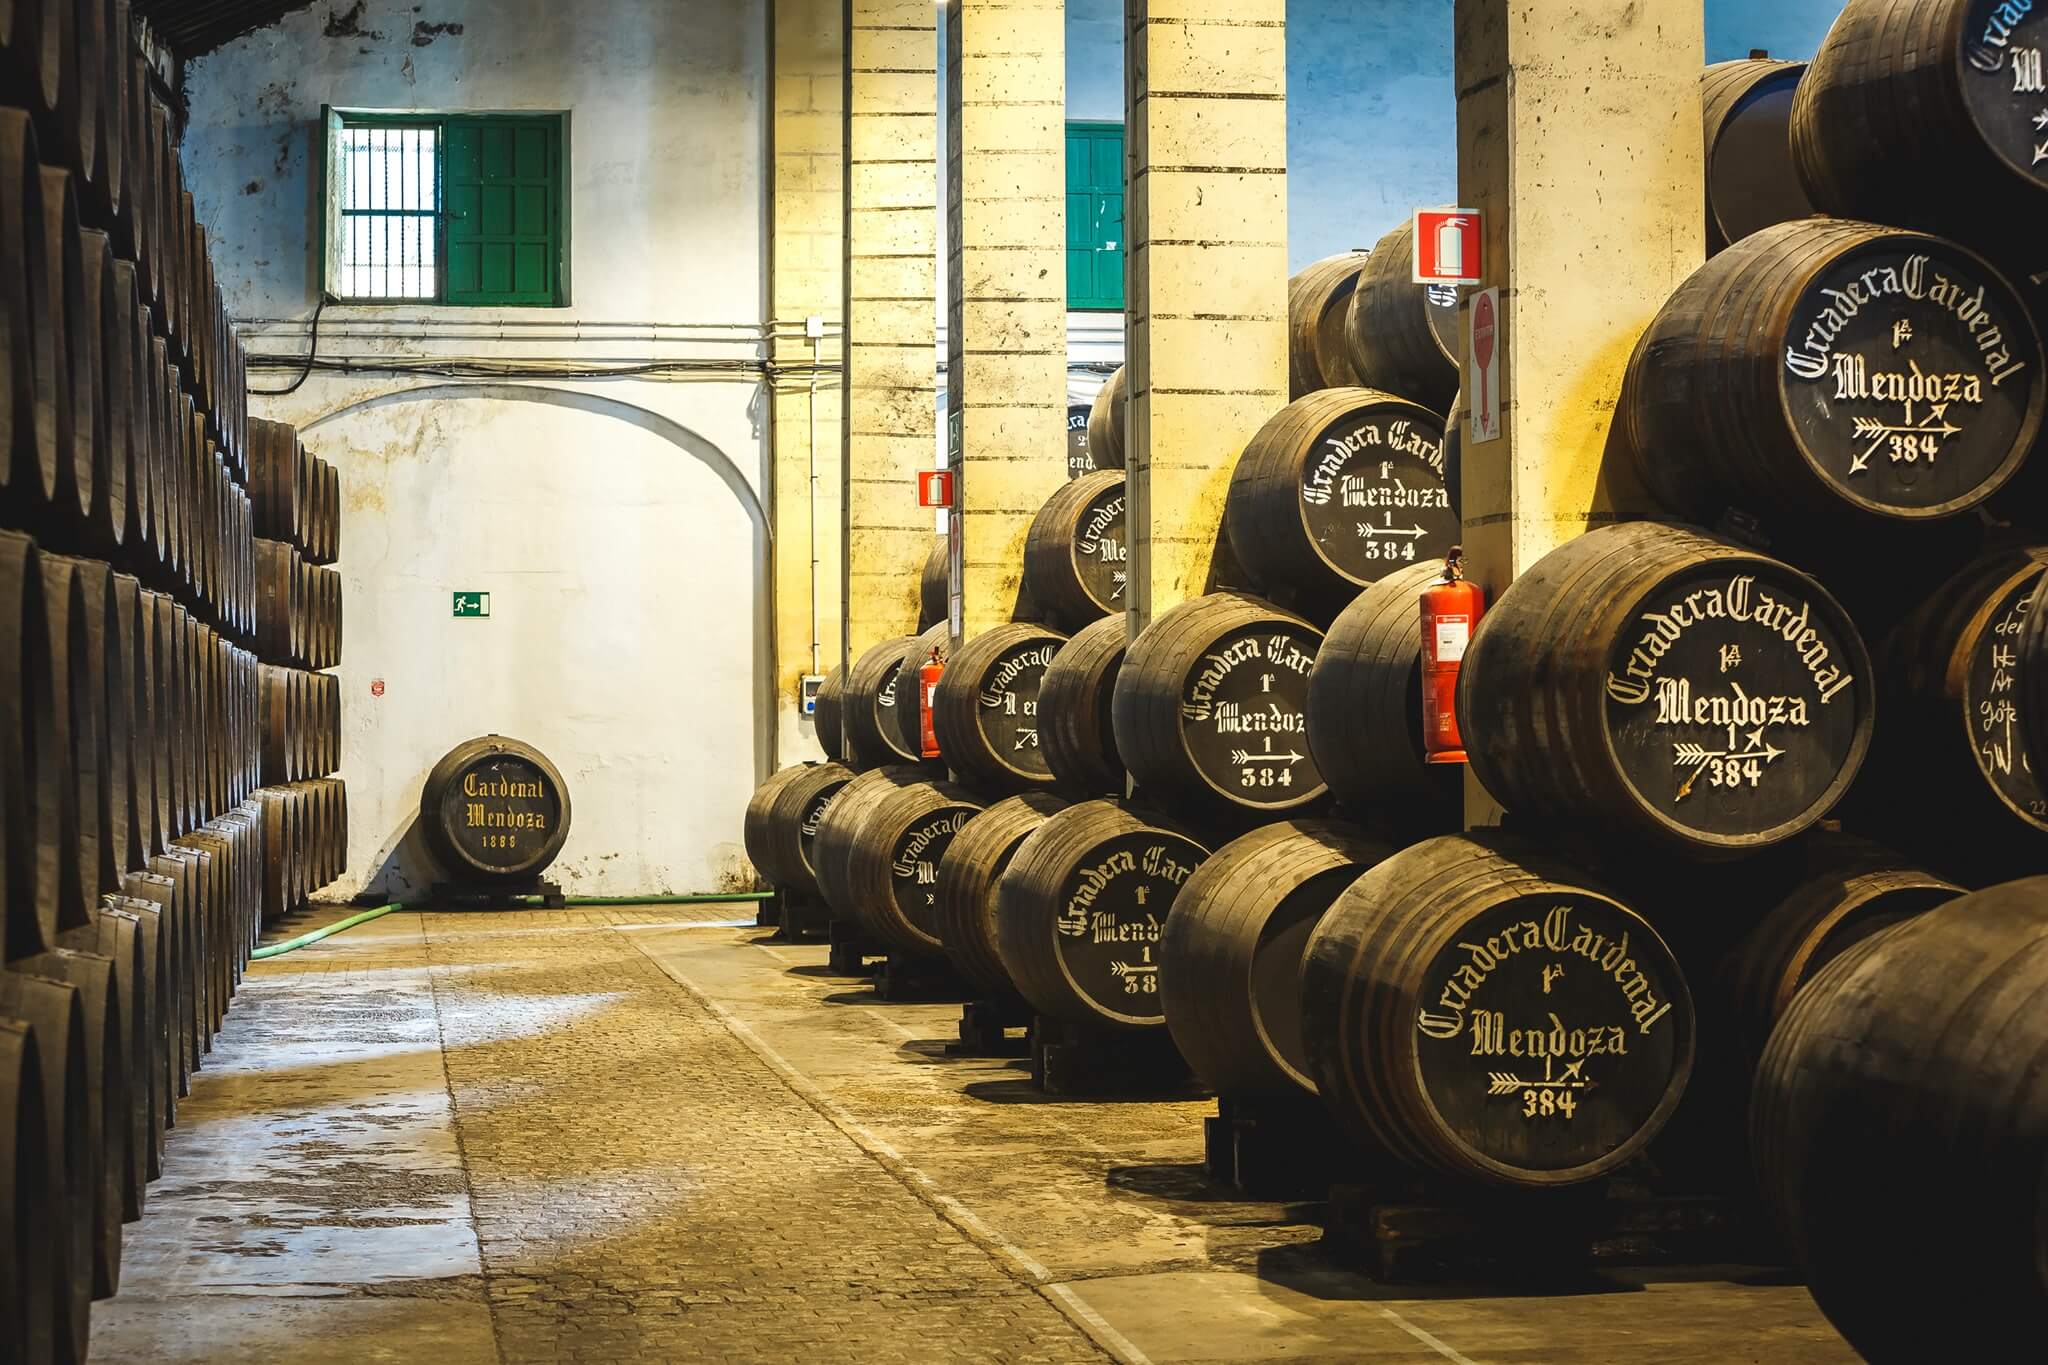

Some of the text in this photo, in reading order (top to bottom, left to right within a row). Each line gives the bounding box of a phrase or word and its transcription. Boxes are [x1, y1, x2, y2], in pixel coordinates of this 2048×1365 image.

[1785, 254, 2025, 385] Criadera Cardenal
[1832, 352, 1983, 404] Mendoza
[1303, 420, 1444, 505] Criadera Card
[1889, 435, 1938, 462] 384
[1340, 475, 1449, 508] Mendoza
[1077, 496, 1126, 554] Criader
[1365, 541, 1416, 560] 384
[1606, 575, 1853, 703] Criadera Cardenal
[980, 651, 1041, 707] Criadera
[1183, 638, 1261, 721] Criadera
[1215, 701, 1305, 733] Mendoz
[1654, 677, 1809, 727] Mendoza
[463, 773, 544, 798] Cardenal
[1241, 768, 1292, 787] 384
[1709, 759, 1762, 787] 384
[466, 803, 545, 828] Mendoza
[892, 820, 951, 877] Criadera
[1091, 912, 1166, 943] Mend
[1124, 975, 1157, 993] 38
[1417, 905, 1672, 1039] Criadera Cardenal
[1470, 1008, 1628, 1058] Mendoza
[1522, 1090, 1577, 1119] 384
